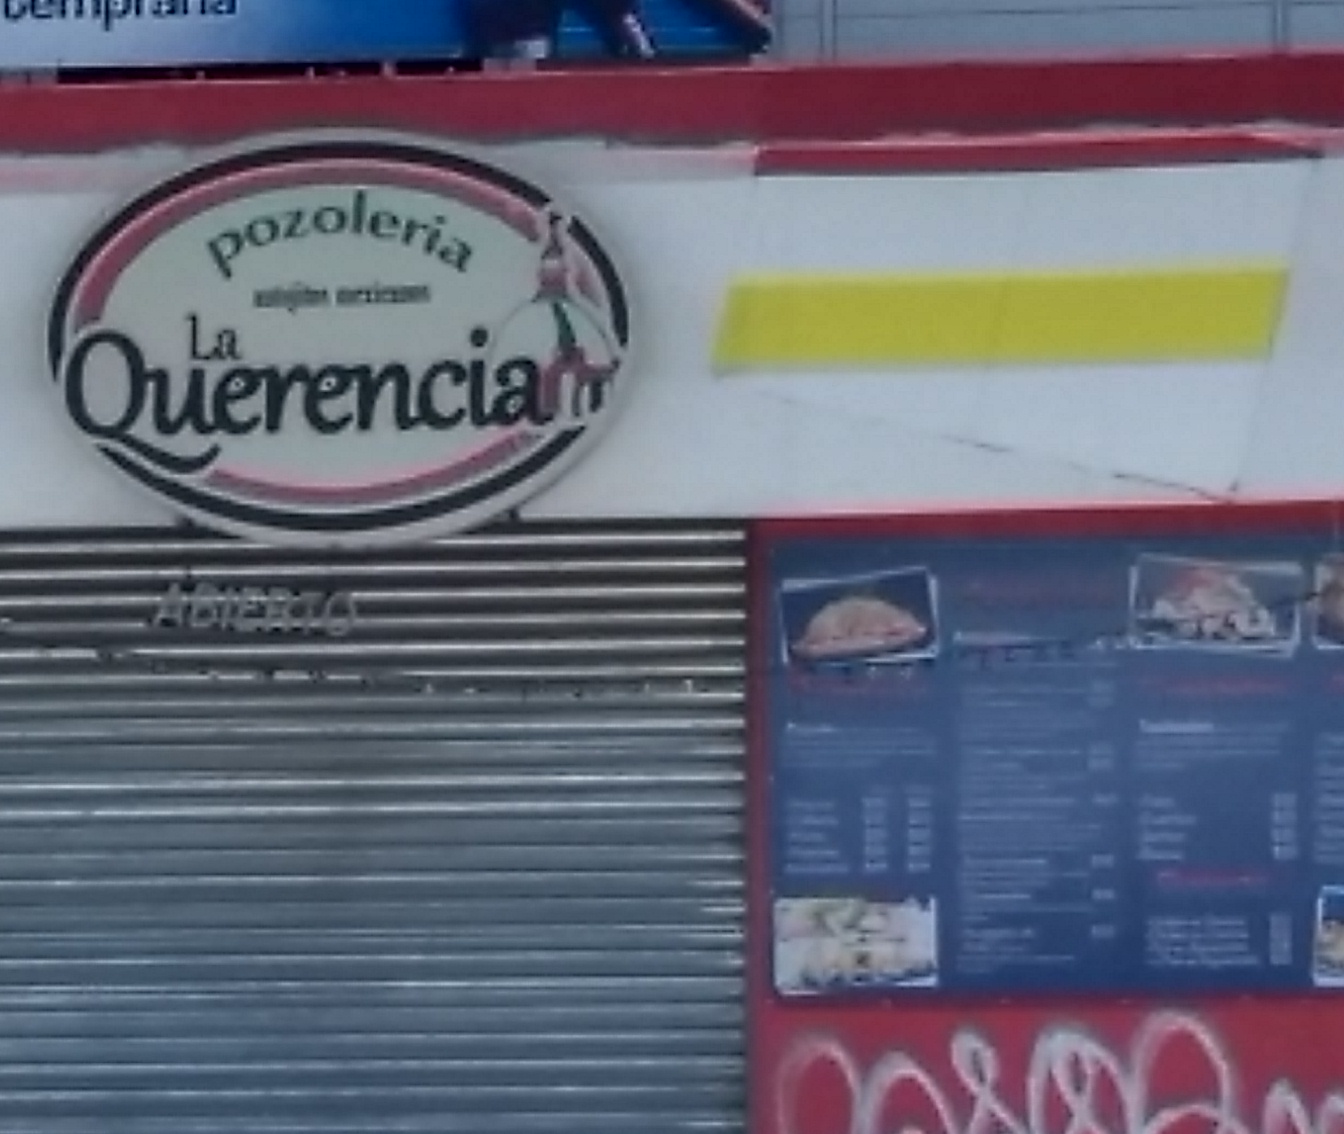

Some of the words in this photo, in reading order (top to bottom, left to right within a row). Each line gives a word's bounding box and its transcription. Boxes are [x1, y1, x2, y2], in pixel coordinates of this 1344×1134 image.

[206, 190, 474, 278] pozoleria
[187, 313, 240, 361] La
[64, 326, 550, 474] Querencia
